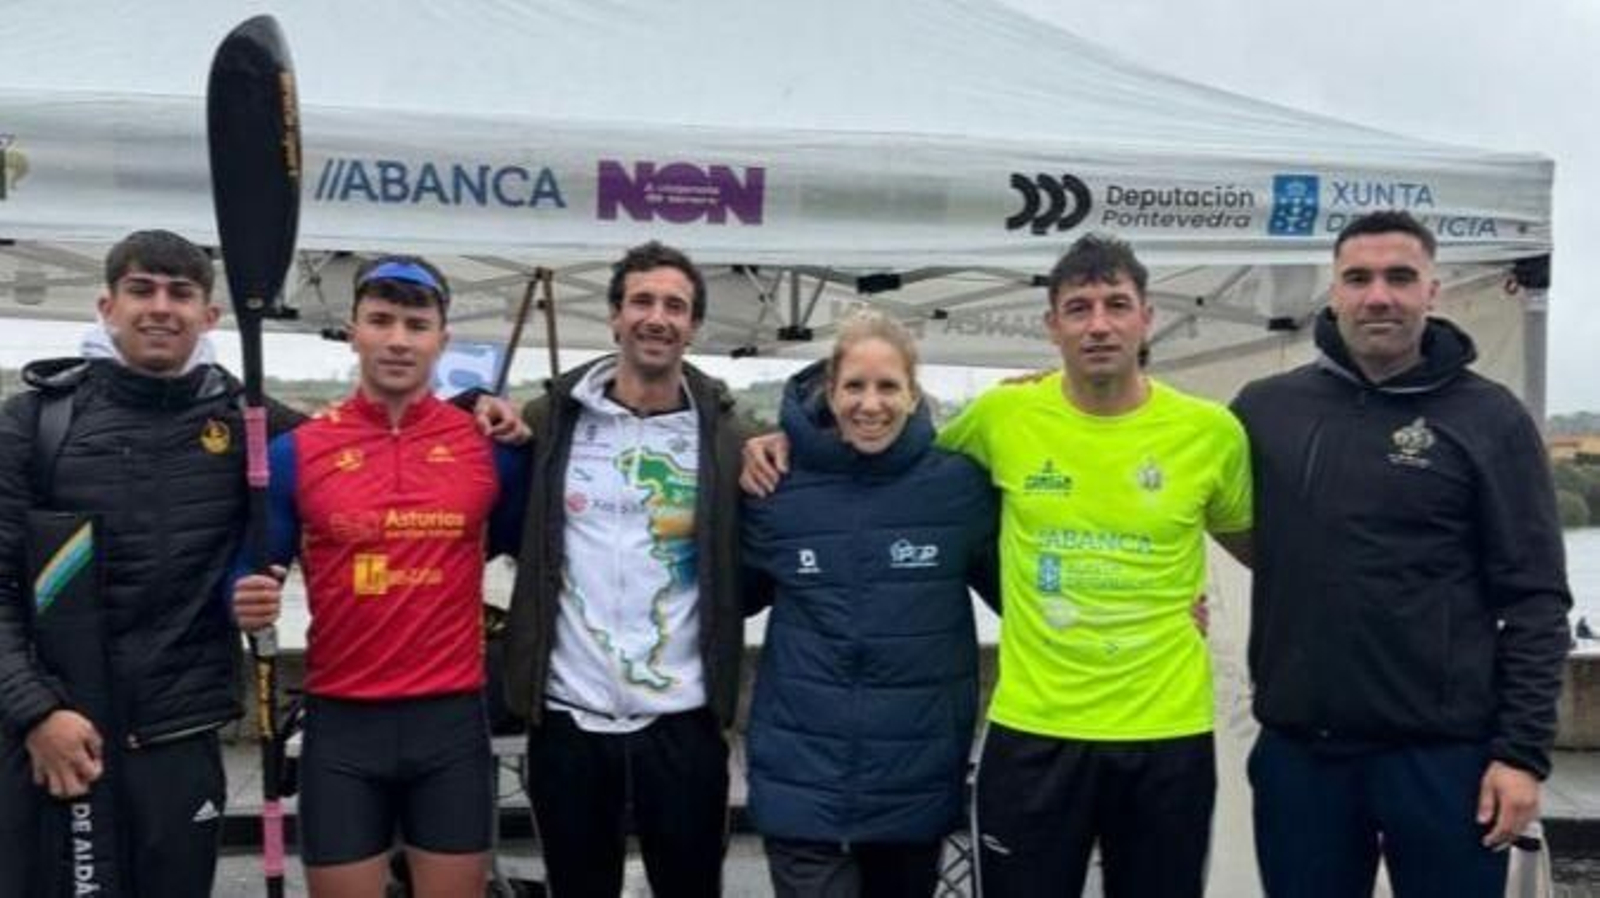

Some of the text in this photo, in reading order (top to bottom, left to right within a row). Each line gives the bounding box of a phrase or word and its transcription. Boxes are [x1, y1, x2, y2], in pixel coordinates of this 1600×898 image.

[597, 160, 766, 225] NON
[1106, 184, 1255, 211] Deputación
[1332, 181, 1435, 207] XUNTA
[1101, 209, 1252, 229] Pontevedra
[384, 508, 466, 528] Asturias
[72, 803, 101, 898] DE ALDÁ
